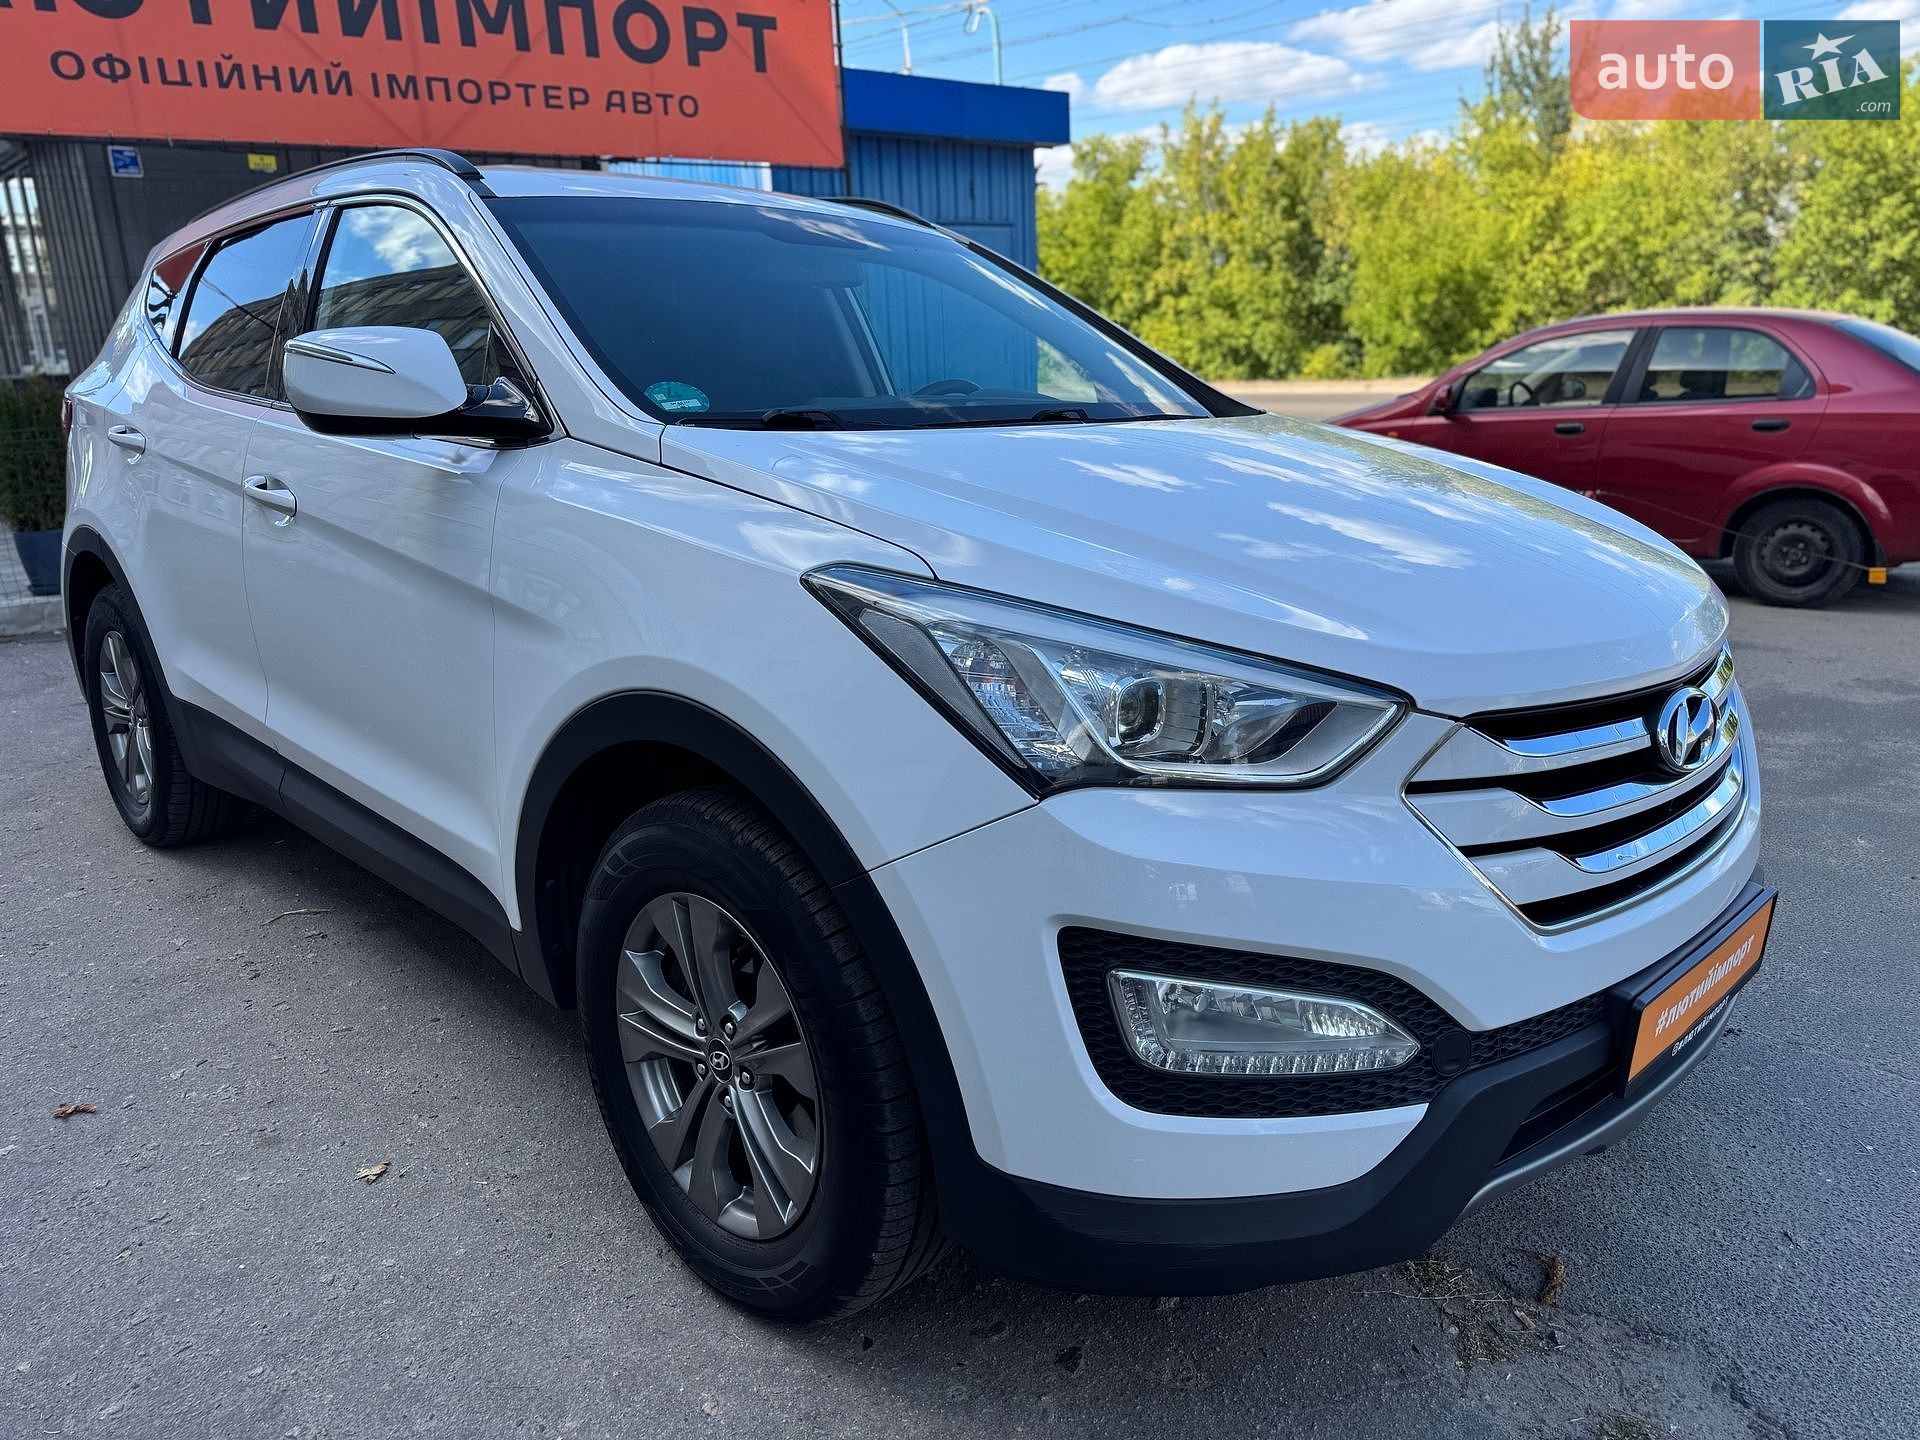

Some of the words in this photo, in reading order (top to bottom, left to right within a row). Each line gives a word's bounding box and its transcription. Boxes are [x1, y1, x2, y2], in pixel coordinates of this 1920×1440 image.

[50, 50, 353, 97] ОФІЦІЙНИЙ
[370, 72, 590, 110] ІМПОРТЕР
[605, 90, 699, 118] АВТО
